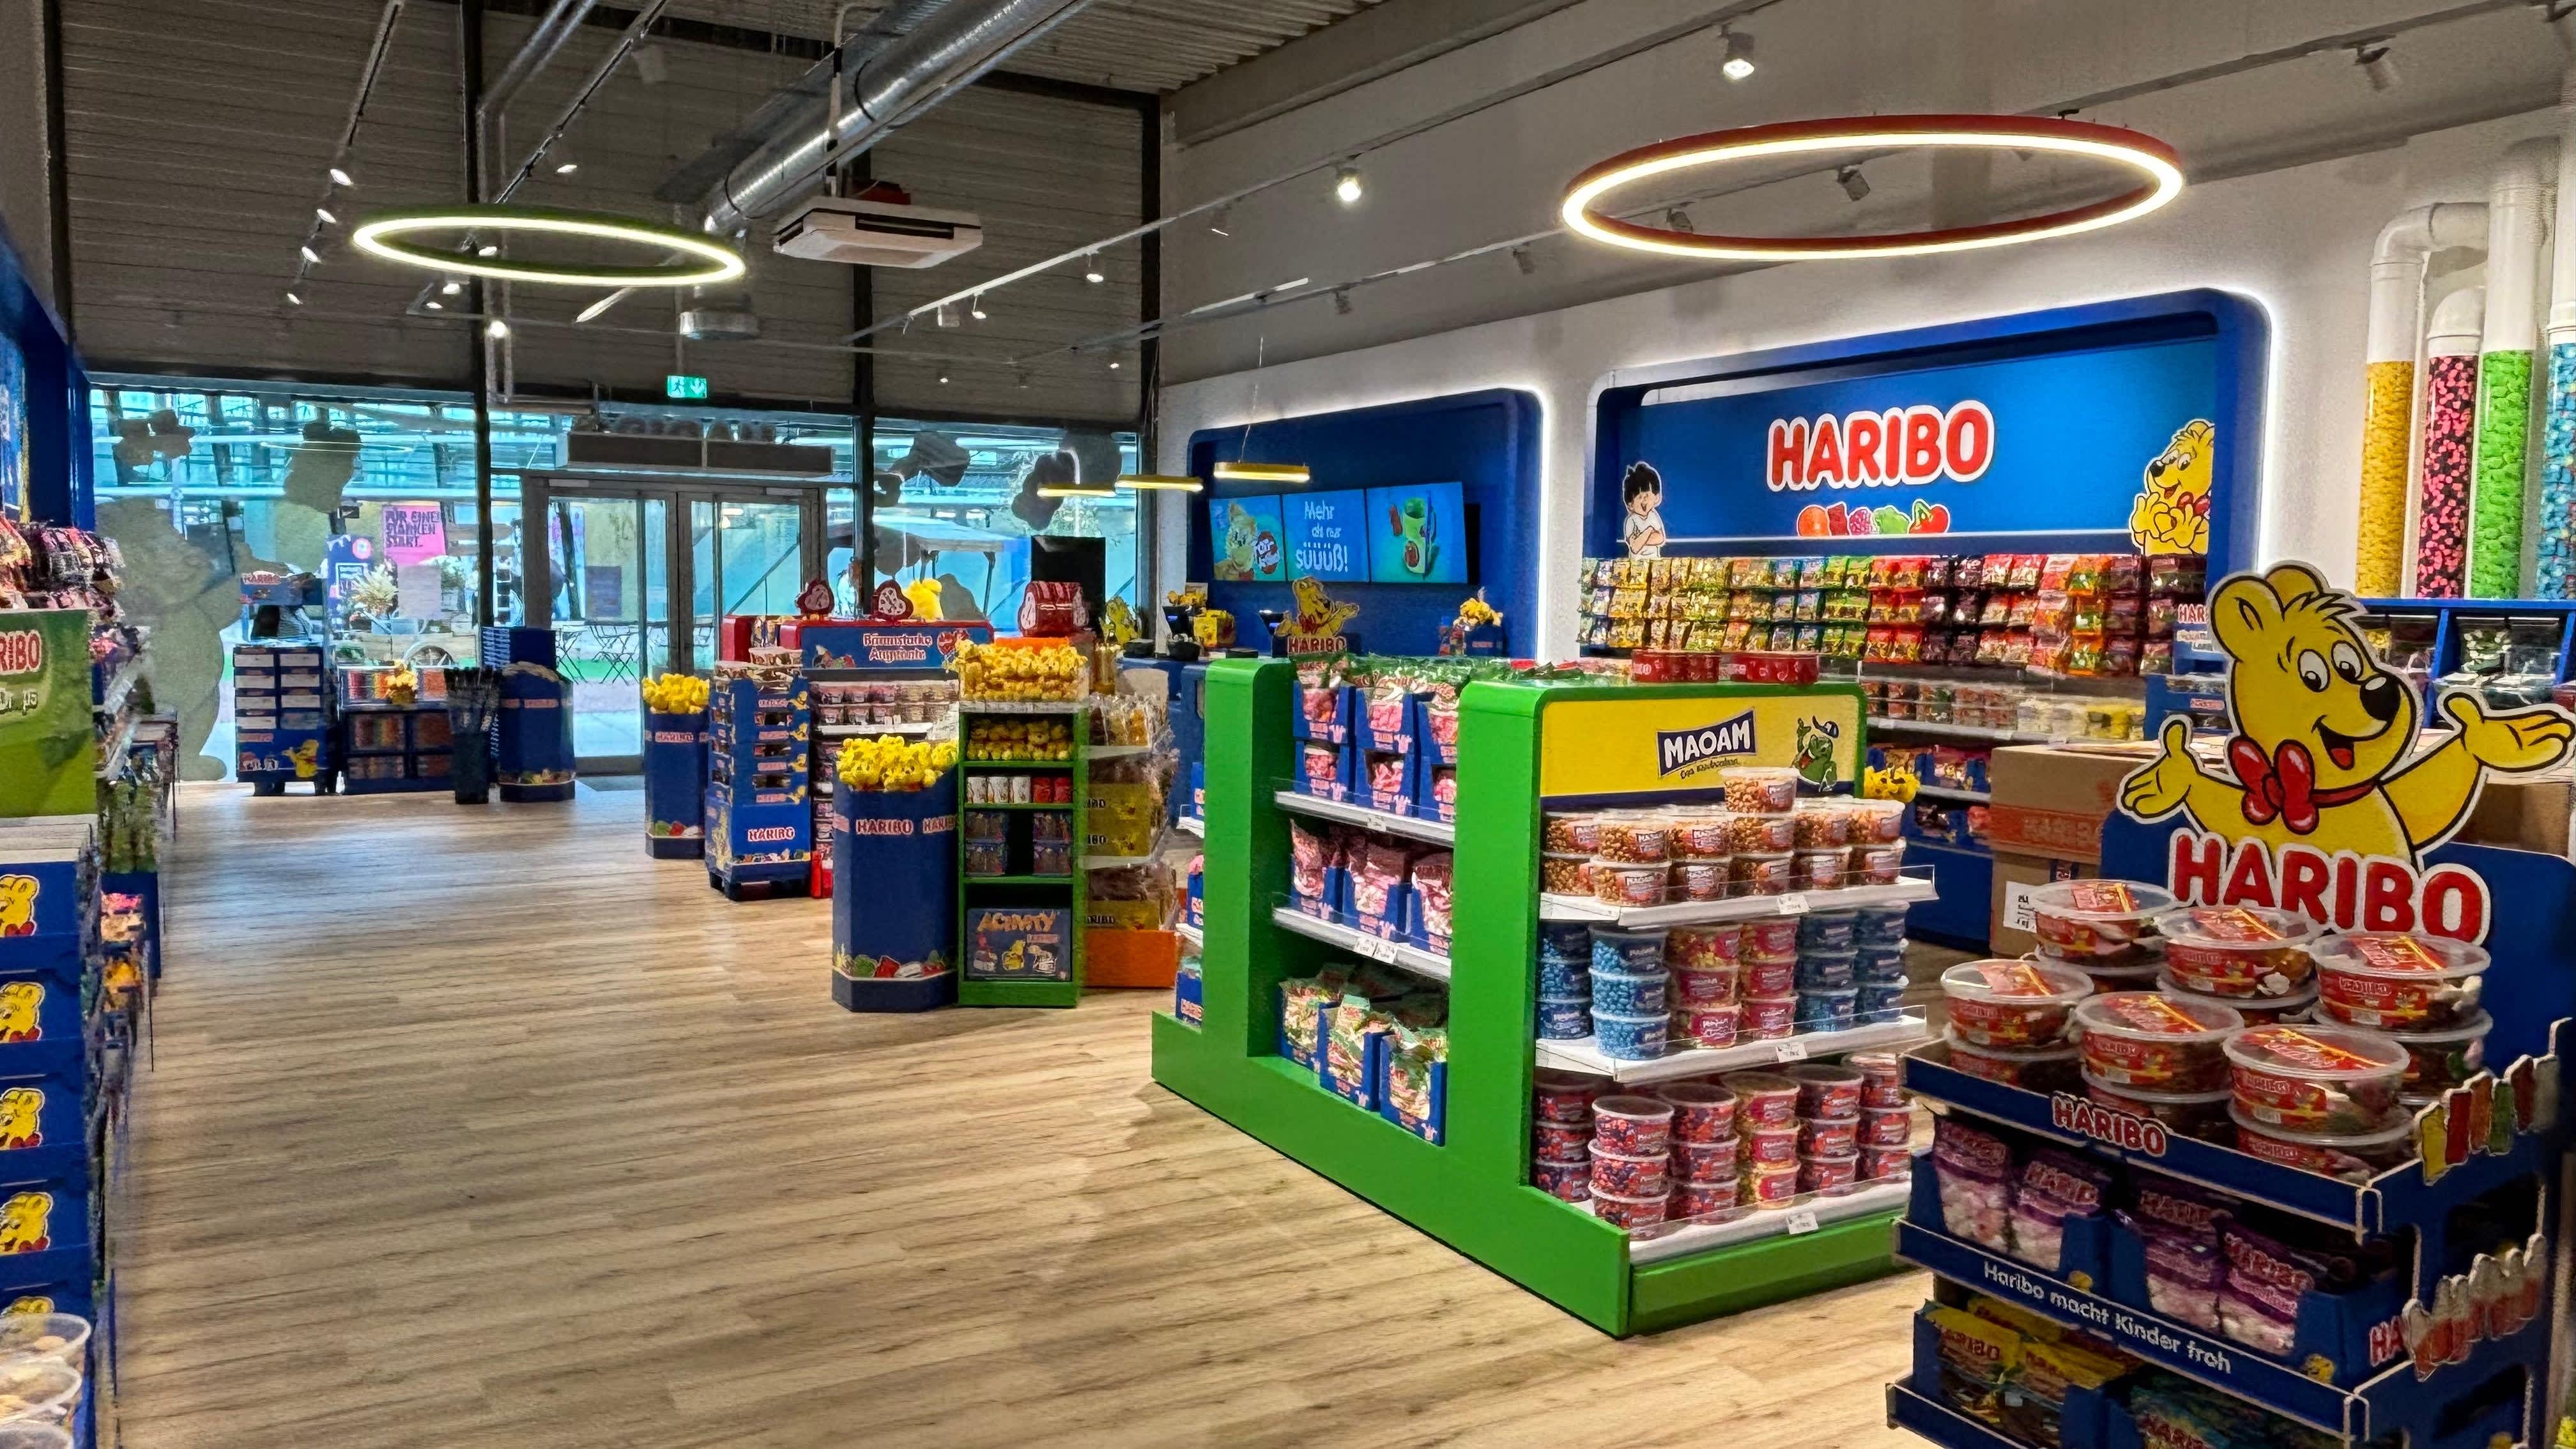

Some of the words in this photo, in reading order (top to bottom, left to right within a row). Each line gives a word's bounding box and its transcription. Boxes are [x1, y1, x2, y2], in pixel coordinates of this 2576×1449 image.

[1768, 401, 1994, 491] HARIBO
[1304, 500, 1335, 520] Mehr
[1287, 636, 1347, 654] HARIBO
[1664, 719, 1751, 769] MAOAM
[747, 826, 795, 842] HARIBO
[855, 818, 914, 835] HARIBO
[2171, 829, 2488, 944] HARIBO
[2051, 1094, 2167, 1158] HARIBO
[1983, 1261, 2044, 1300] Haribo
[2050, 1291, 2110, 1325] macht
[2115, 1312, 2181, 1353] Kinder
[2186, 1340, 2232, 1374] froh
